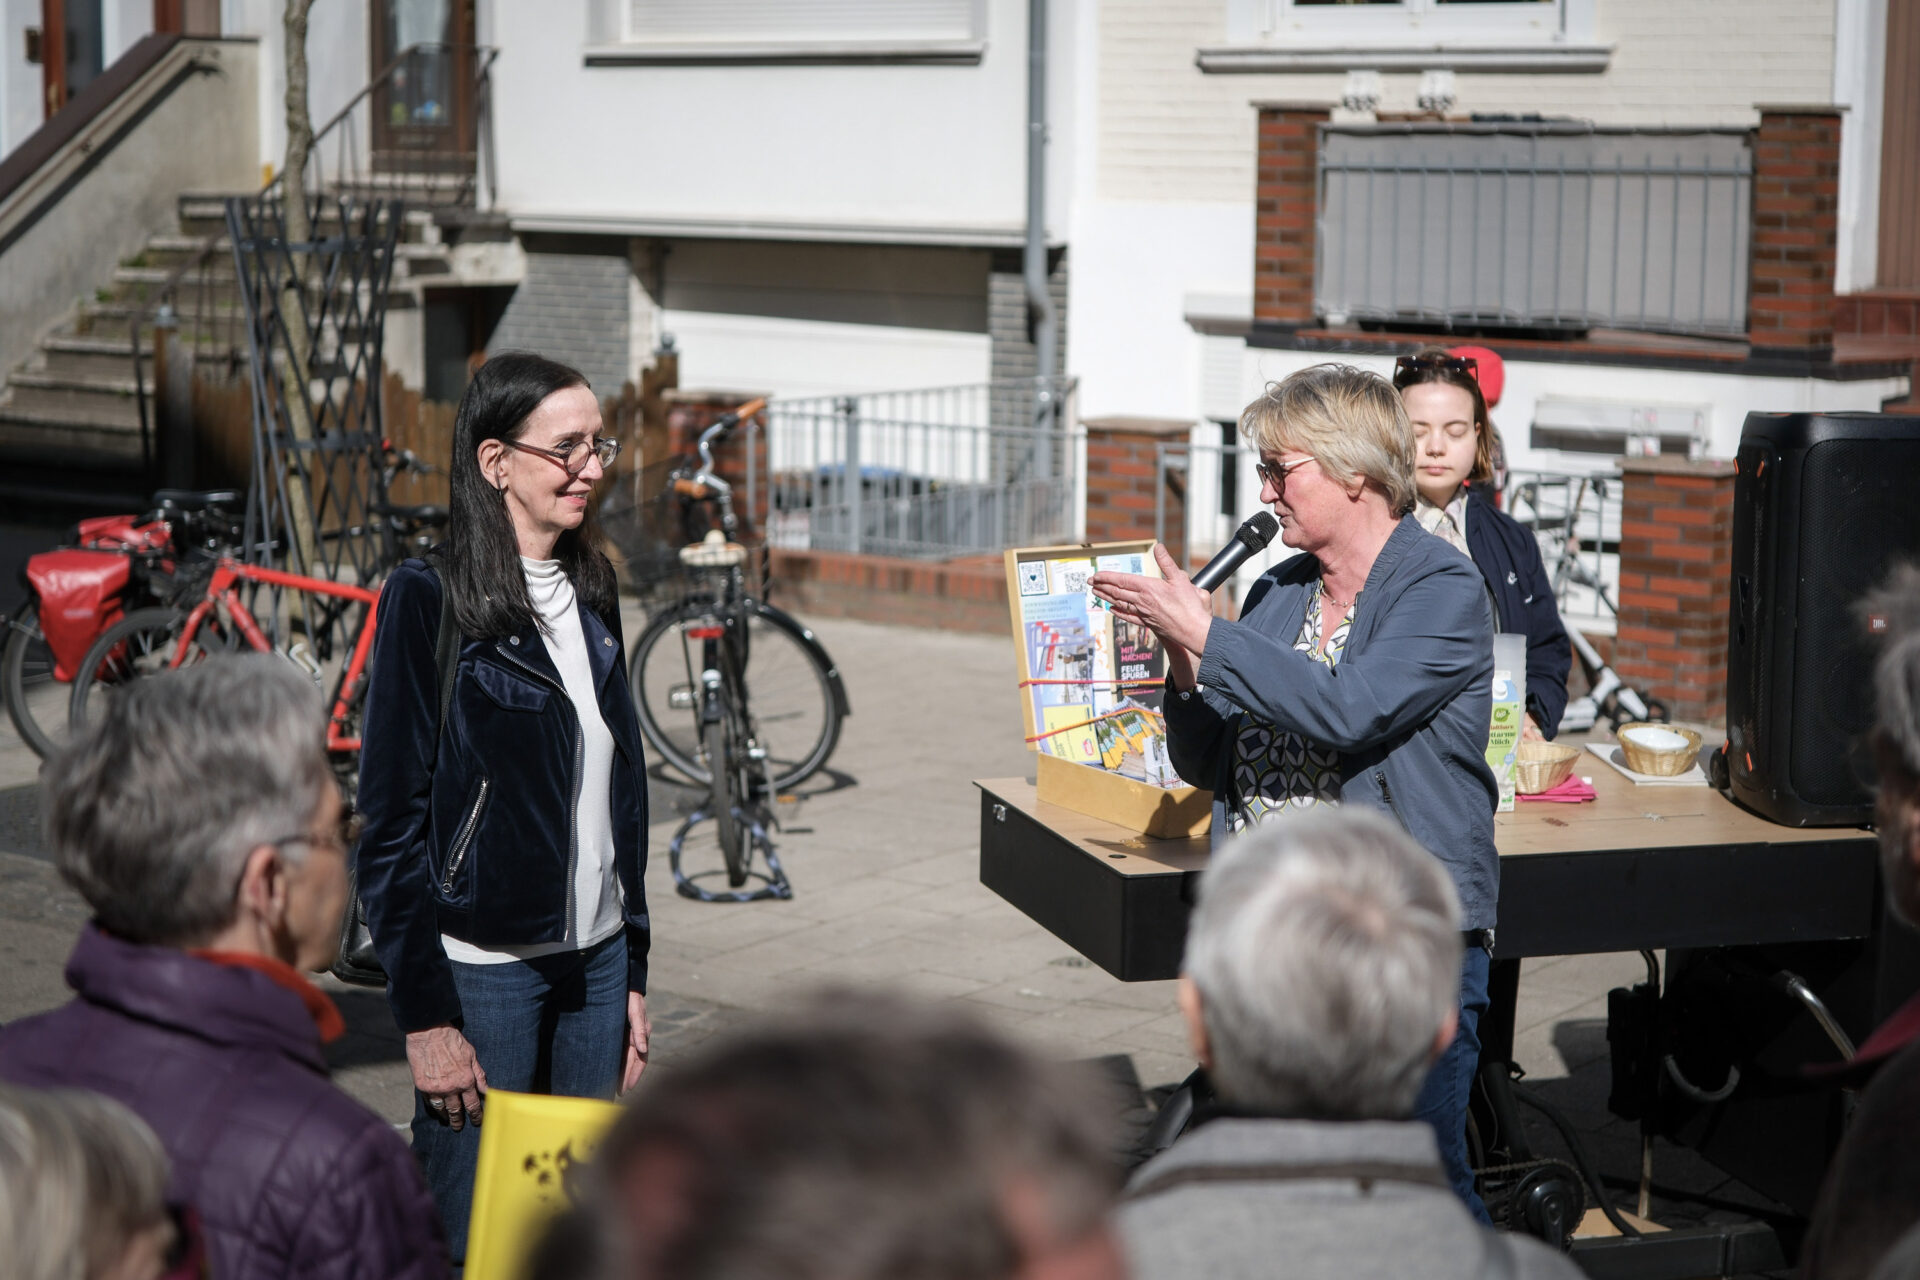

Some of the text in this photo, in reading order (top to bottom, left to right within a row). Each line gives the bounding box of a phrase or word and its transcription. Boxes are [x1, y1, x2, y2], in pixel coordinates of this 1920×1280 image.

[1121, 646, 1134, 654] MIT
[1121, 652, 1153, 662] MACHEN!
[1121, 664, 1145, 673] FEUER
[1121, 670, 1150, 681] SPUREN
